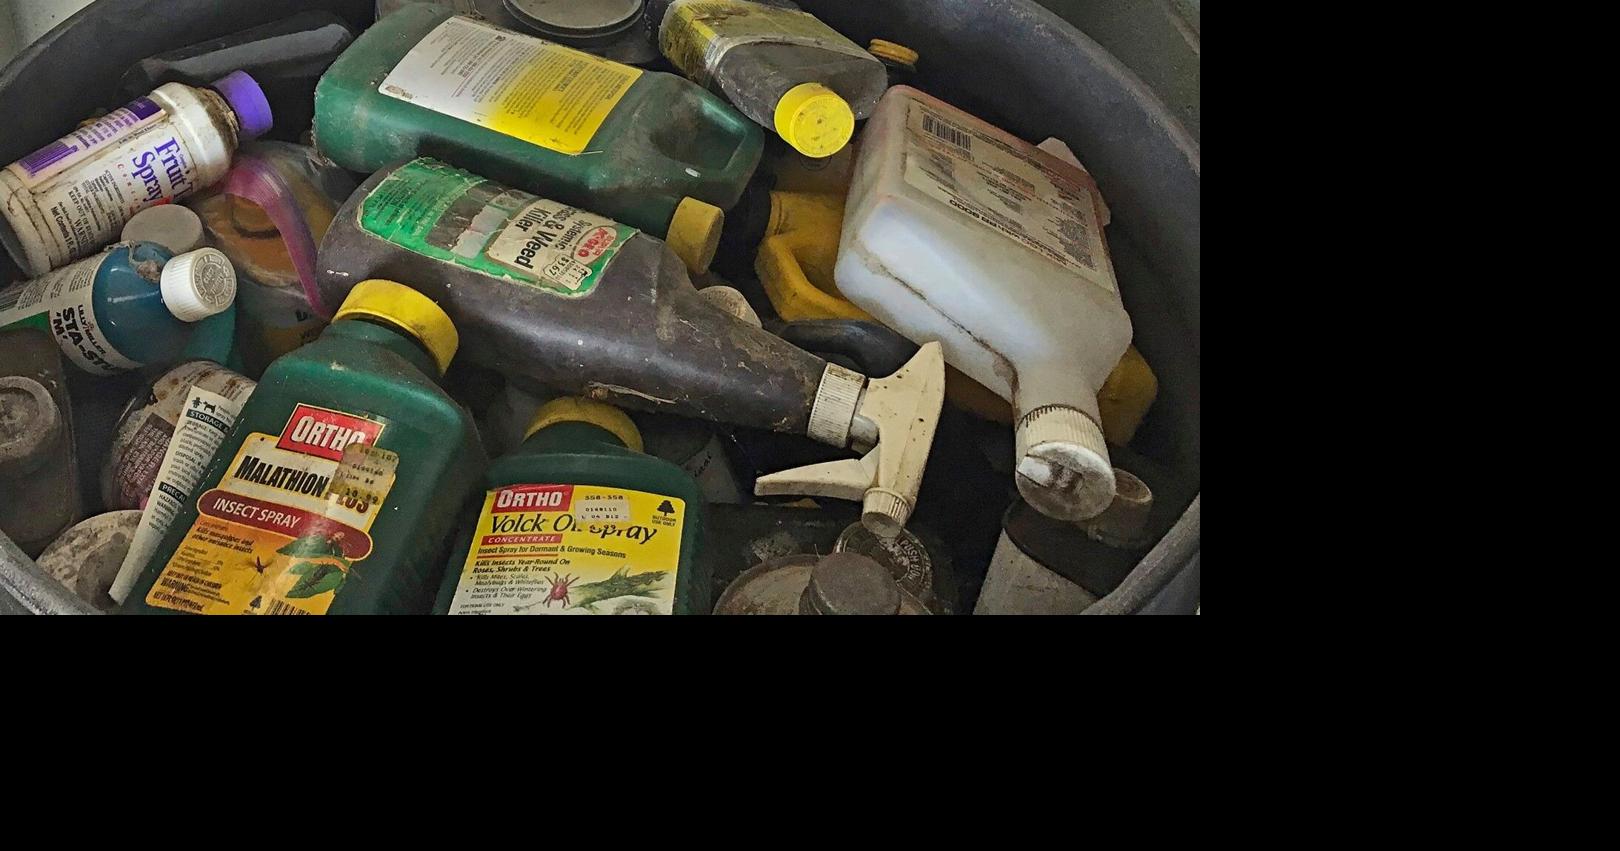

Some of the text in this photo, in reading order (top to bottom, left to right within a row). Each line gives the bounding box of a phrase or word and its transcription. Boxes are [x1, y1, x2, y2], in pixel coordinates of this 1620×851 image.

[153, 137, 188, 189] Fruit
[131, 153, 162, 200] Spray
[514, 207, 550, 232] Killer
[543, 220, 564, 230] &
[513, 230, 557, 269] Weed
[77, 304, 87, 326] LILLY
[189, 410, 223, 428] STORAGE
[234, 455, 330, 498] MALATHION
[497, 489, 563, 508] ORTHO
[213, 497, 301, 529] INSECT SPRAY
[492, 513, 549, 533] Volck
[488, 535, 556, 544] CONCENTRATE
[900, 539, 918, 560] PUSH
[499, 546, 517, 554] Spray
[567, 545, 596, 555] Growing
[597, 548, 626, 558] Seasons
